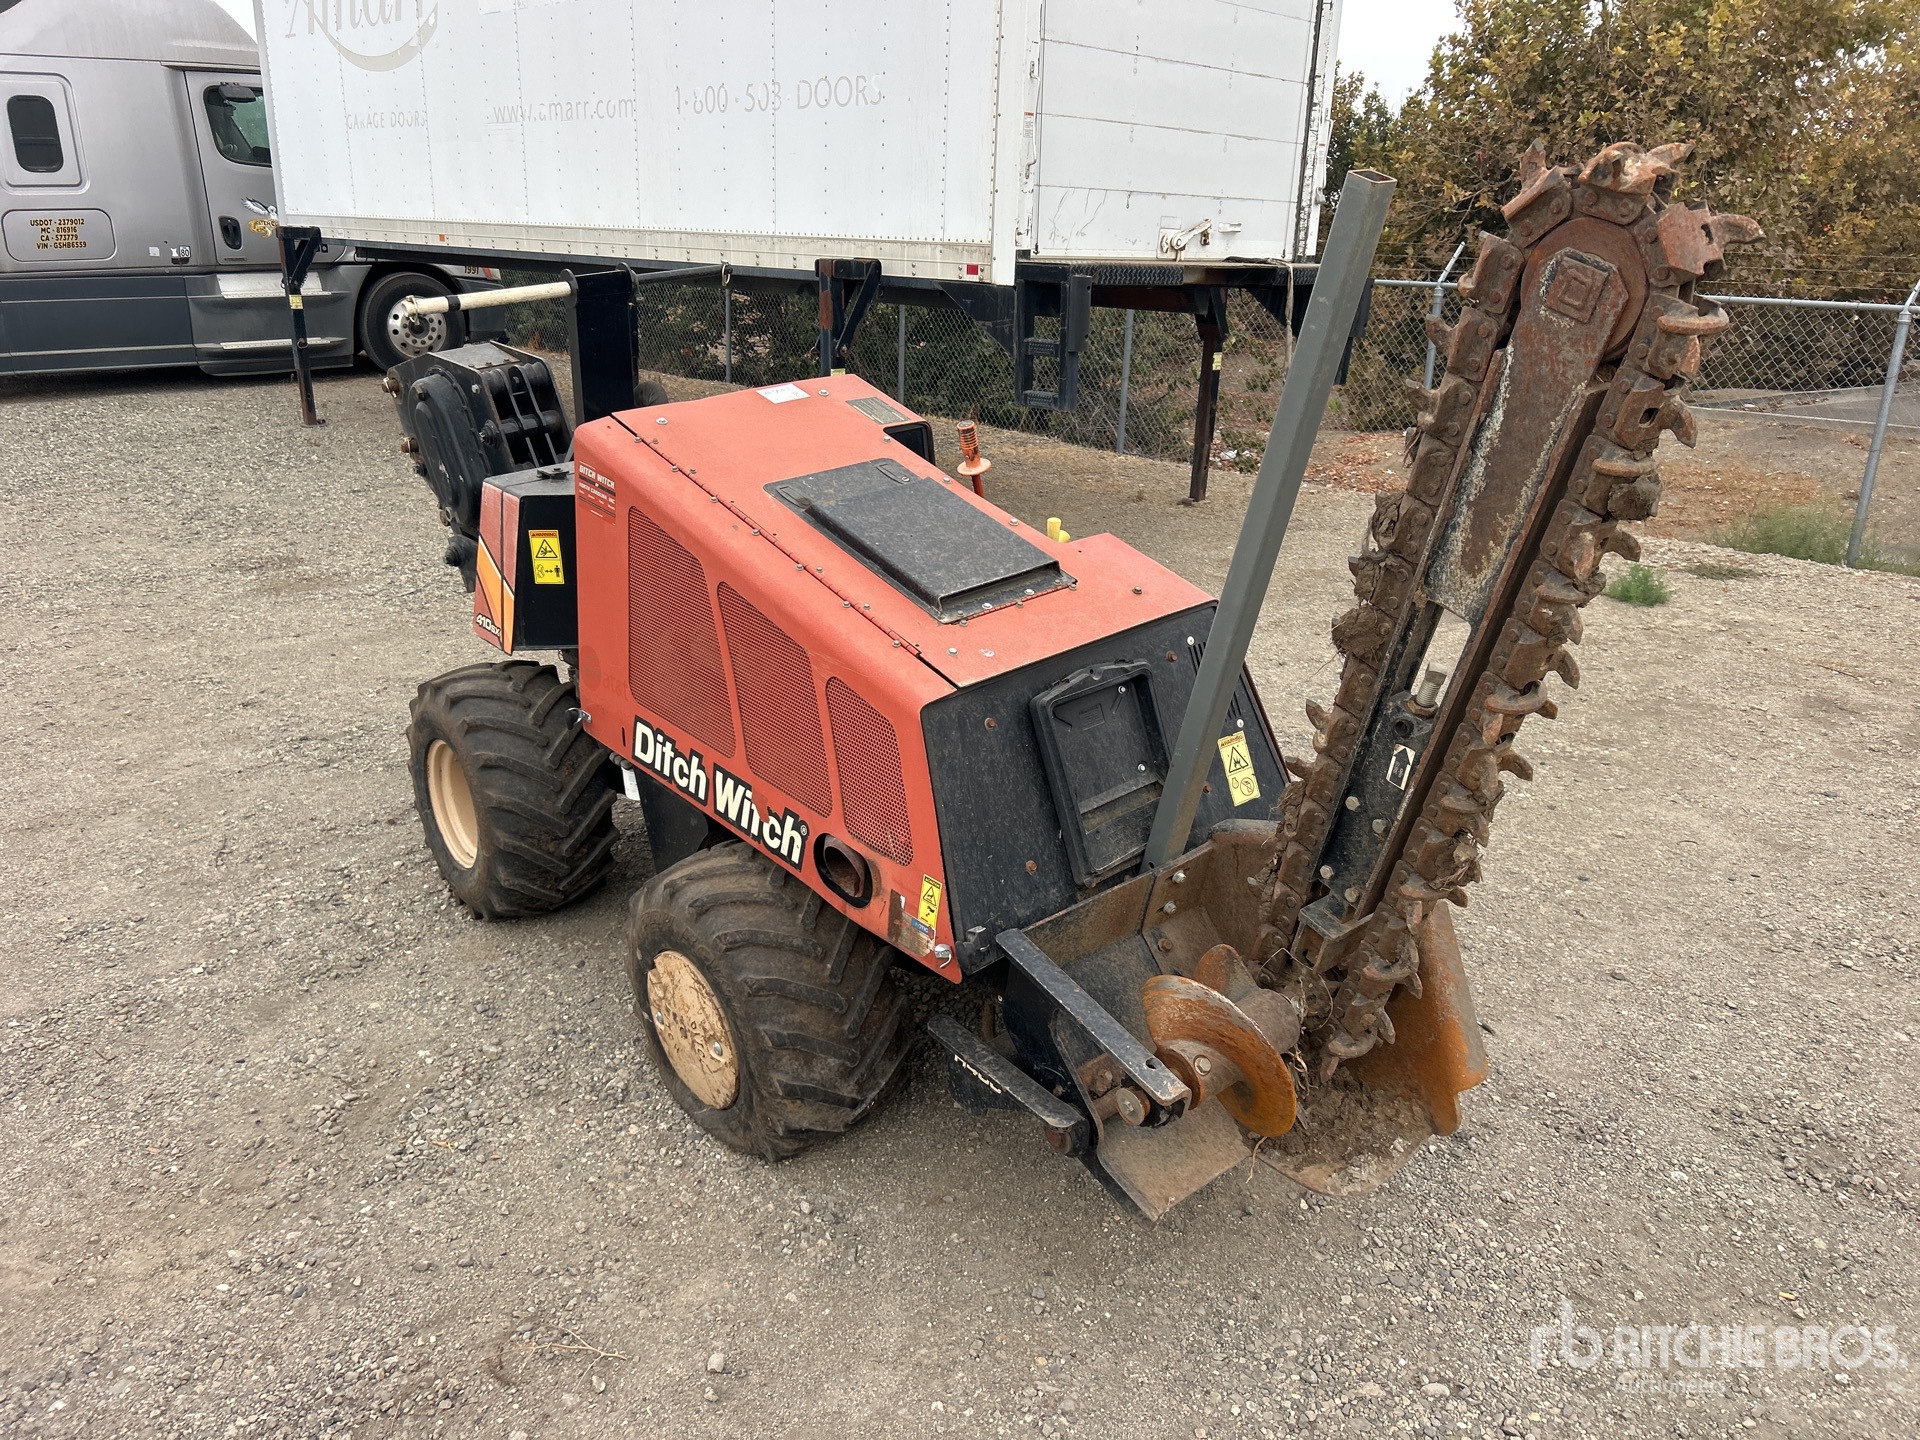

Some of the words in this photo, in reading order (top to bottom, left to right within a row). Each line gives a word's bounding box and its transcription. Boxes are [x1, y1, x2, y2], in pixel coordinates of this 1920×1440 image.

[492, 98, 635, 123] www.amarr.com
[30, 219, 53, 227] USDOT
[58, 218, 85, 226] 2379012
[56, 226, 78, 234] 816916
[40, 234, 50, 242] CA
[55, 233, 79, 241] 573779
[36, 242, 49, 250] VIN
[579, 464, 596, 480] DITCH
[596, 473, 615, 489] WITCH
[633, 719, 709, 803] Ditch
